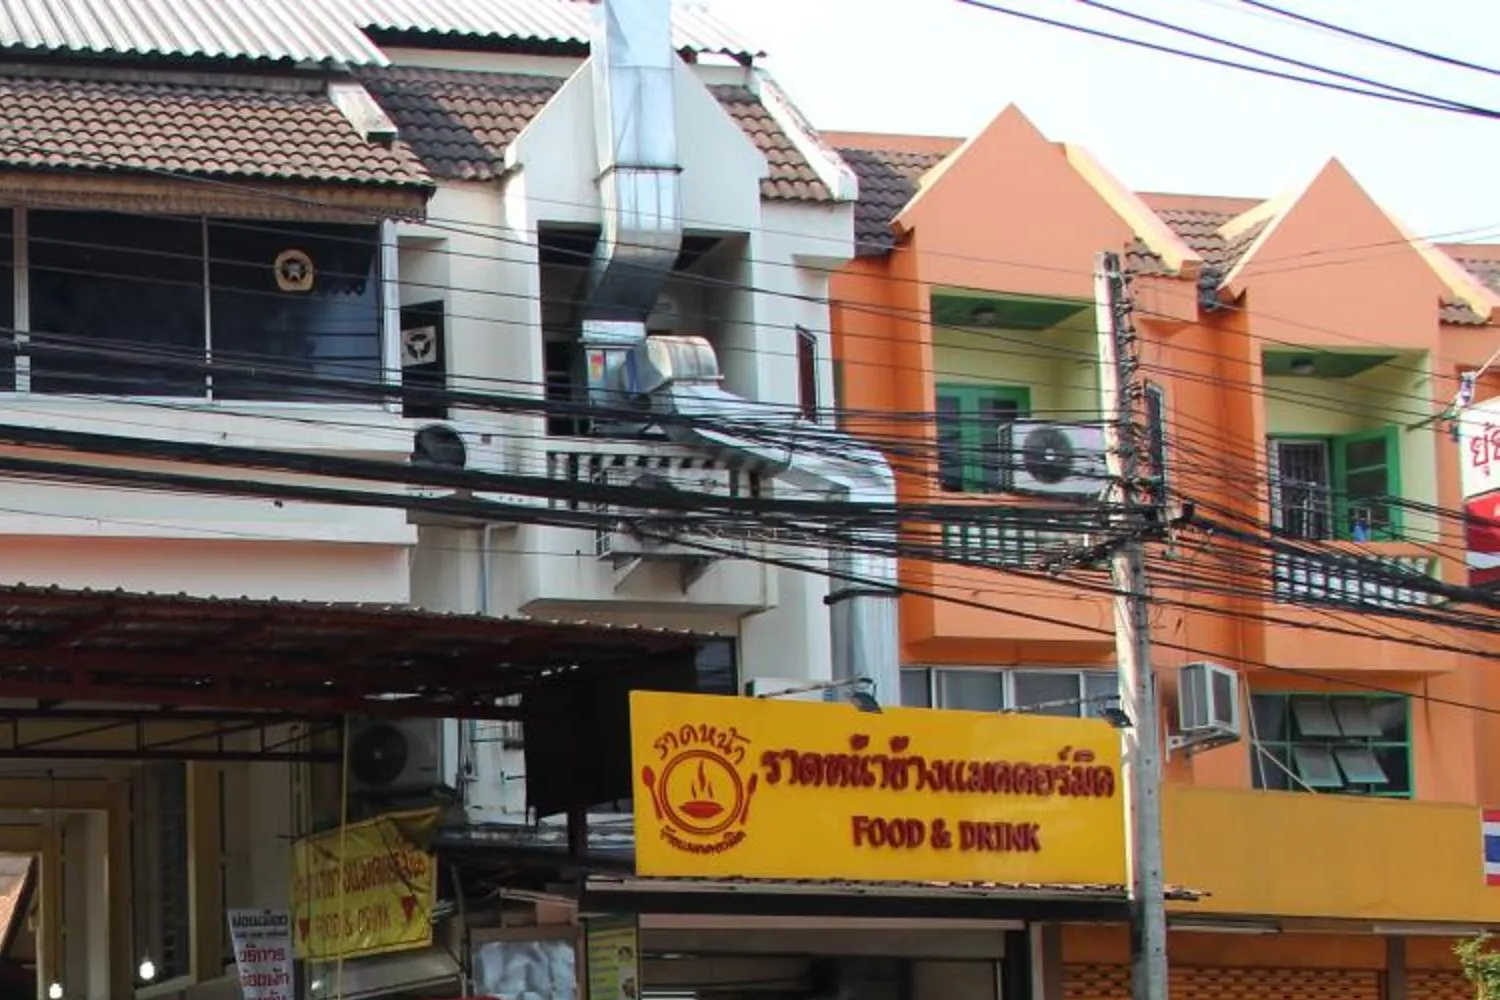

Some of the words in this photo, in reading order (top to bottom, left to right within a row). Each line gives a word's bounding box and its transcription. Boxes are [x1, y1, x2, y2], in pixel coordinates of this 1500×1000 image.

[851, 815, 925, 848] FOOD
[930, 817, 952, 849] &
[958, 820, 1041, 853] DRINK
